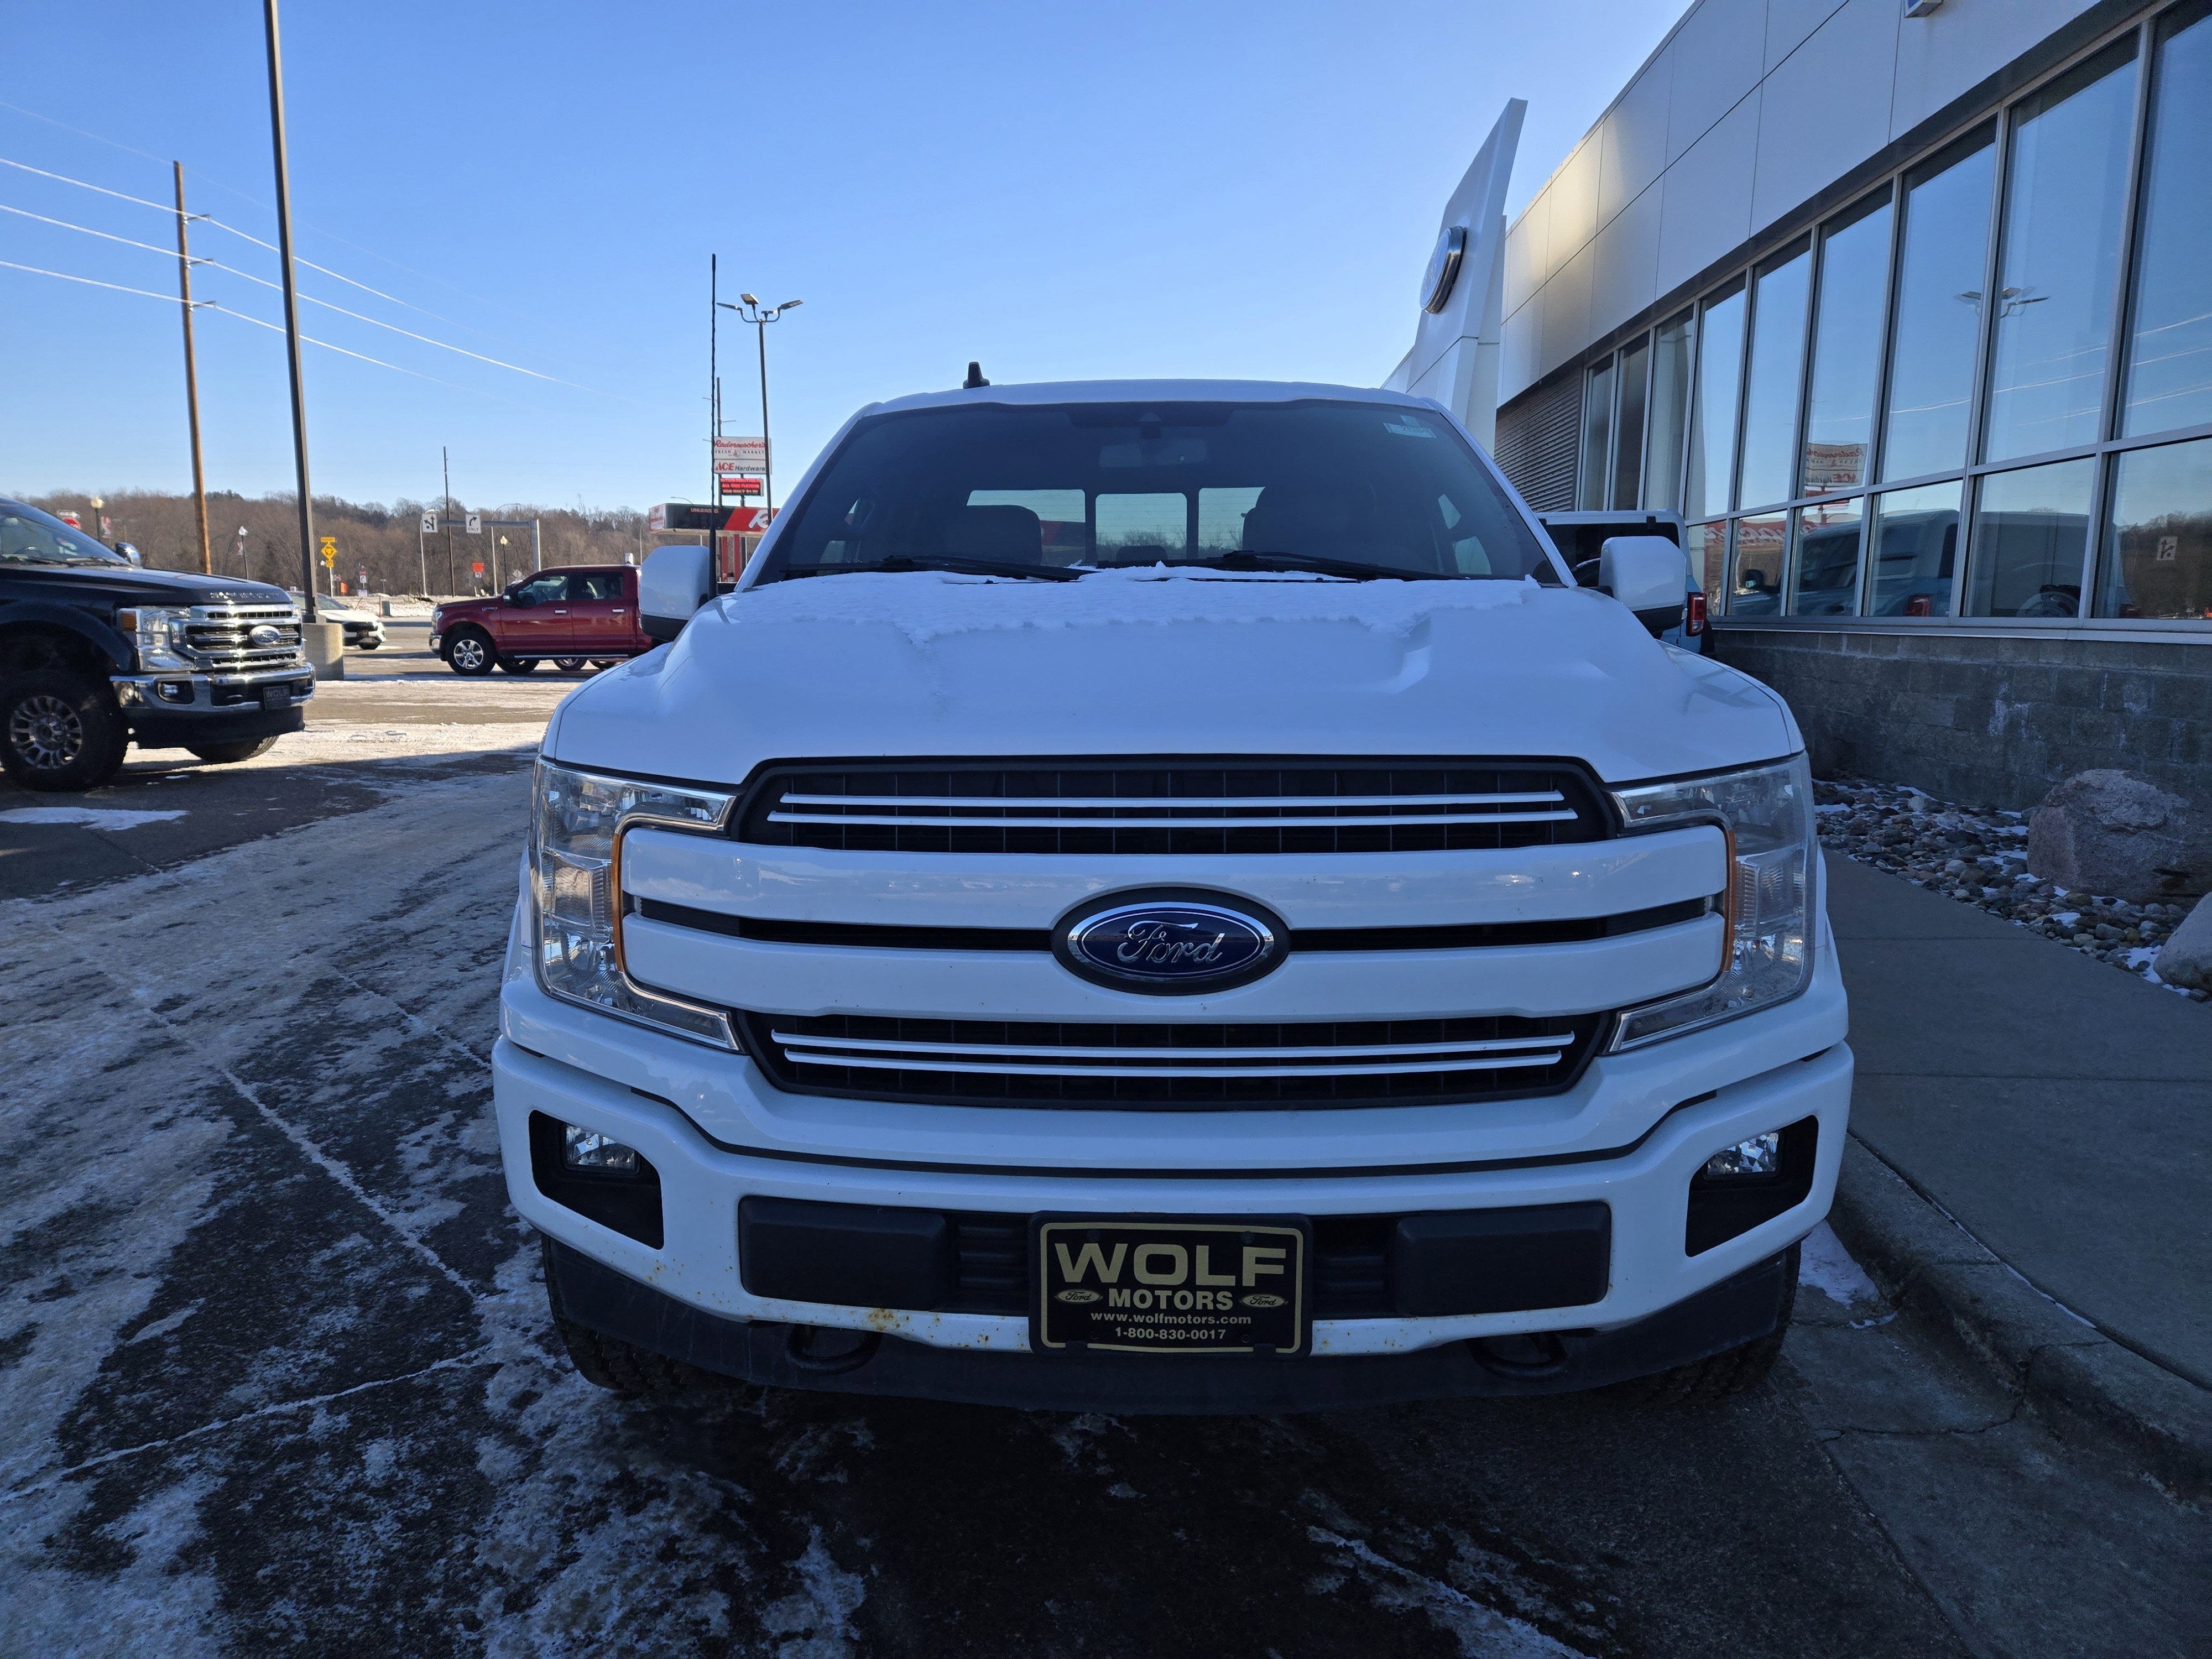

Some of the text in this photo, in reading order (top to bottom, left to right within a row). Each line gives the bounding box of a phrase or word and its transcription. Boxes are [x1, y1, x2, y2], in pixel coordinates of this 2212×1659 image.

[715, 461, 734, 471] ACE
[1117, 920, 1225, 963] Ford
[1054, 1243, 1286, 1287] WOLF
[1065, 1291, 1092, 1302] Ford
[1109, 1288, 1233, 1310] MOTORS
[1249, 1295, 1277, 1306] Ford
[1091, 1313, 1251, 1325] www.wolfmotors.com
[1115, 1327, 1227, 1340] 1-800-830-0017
